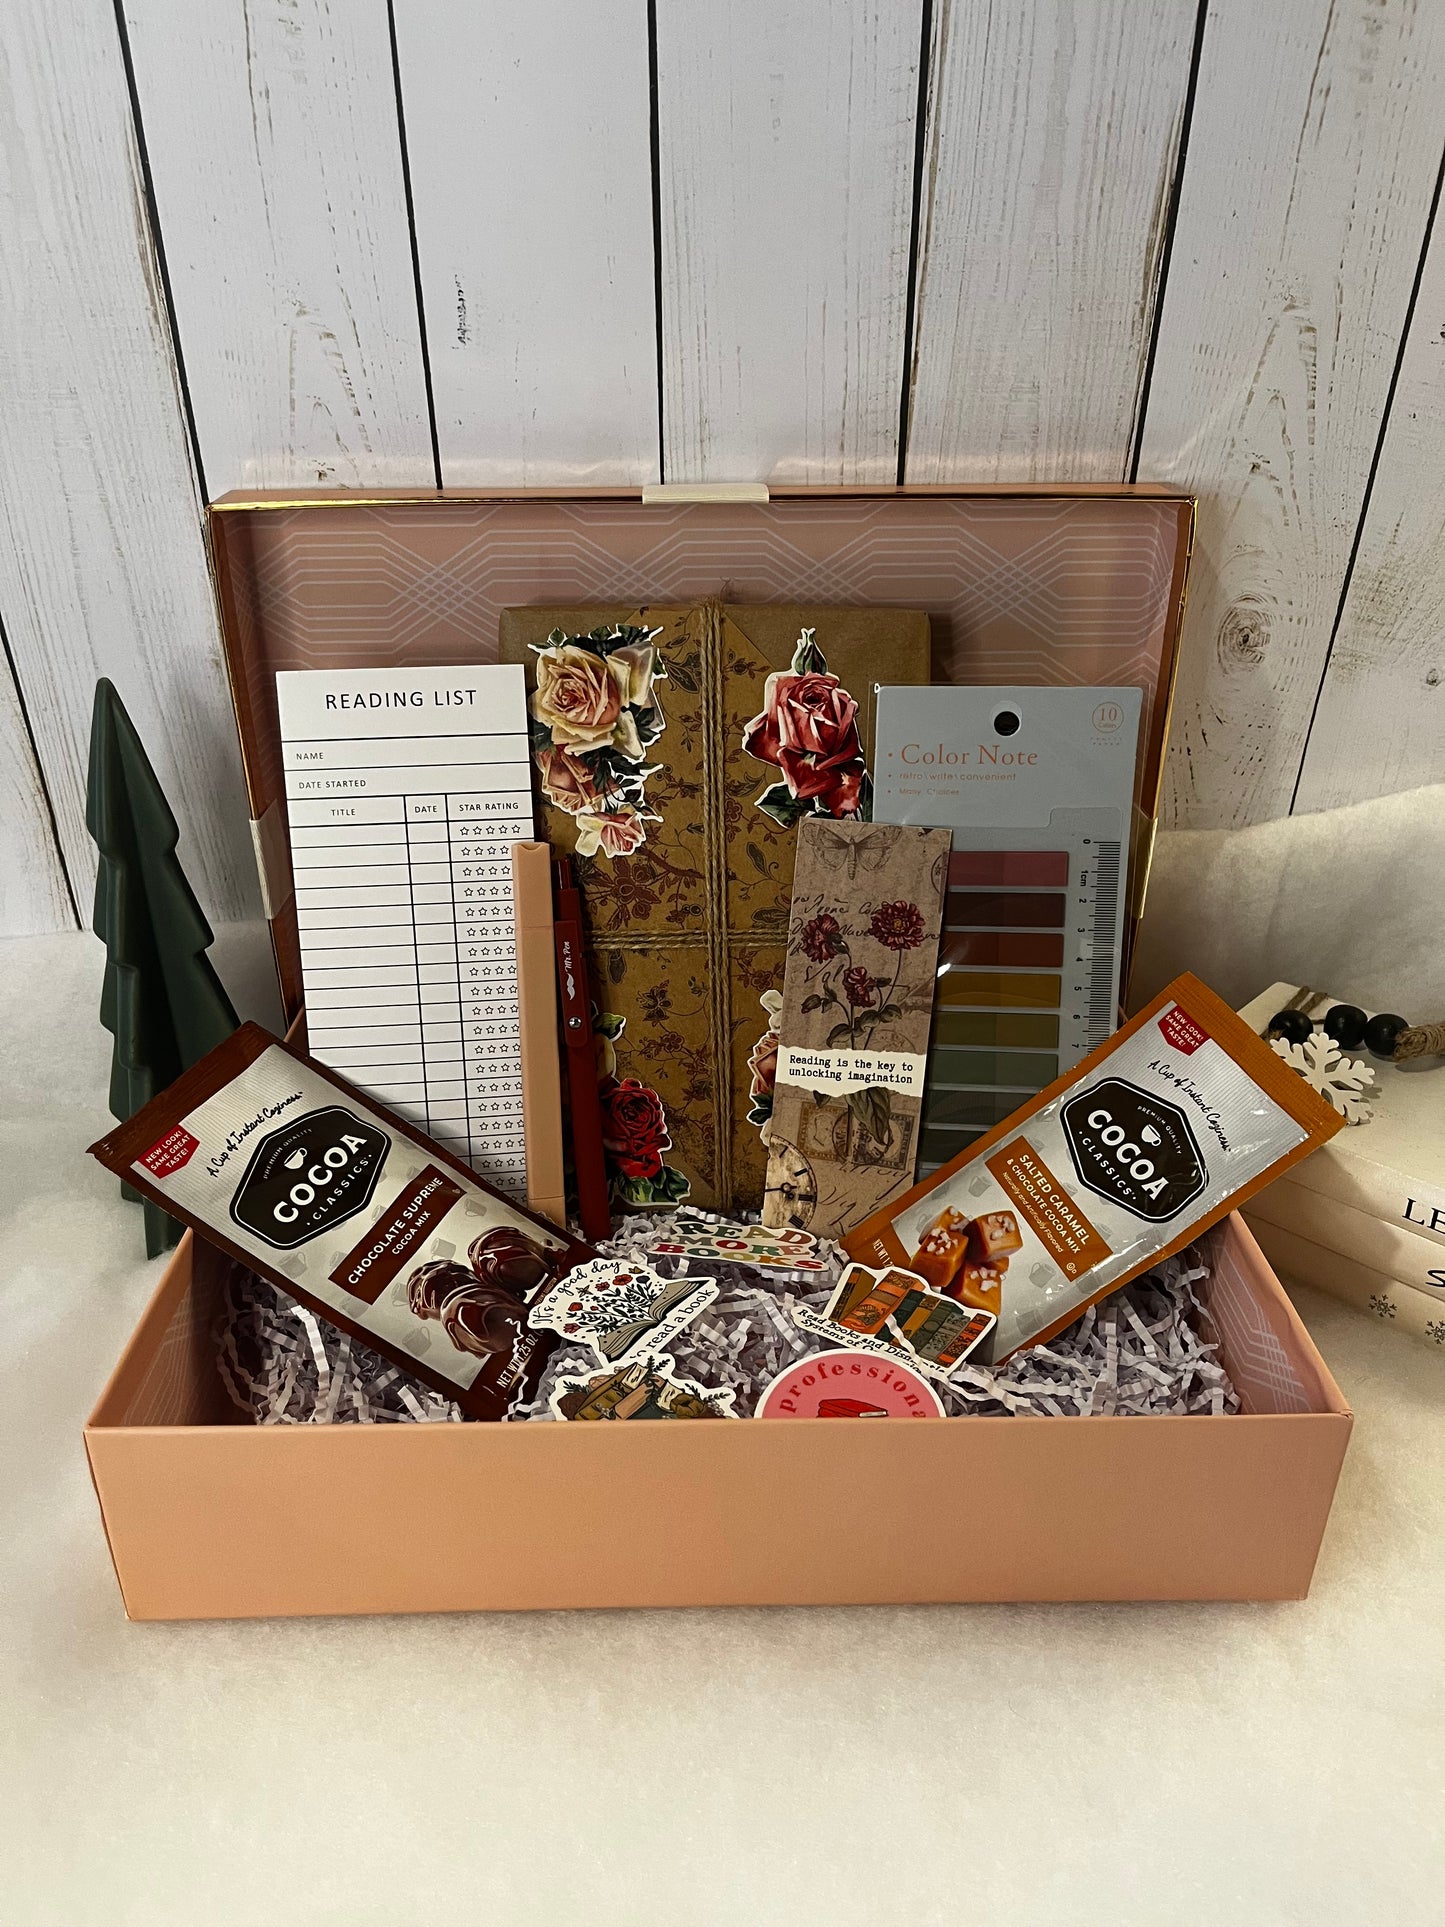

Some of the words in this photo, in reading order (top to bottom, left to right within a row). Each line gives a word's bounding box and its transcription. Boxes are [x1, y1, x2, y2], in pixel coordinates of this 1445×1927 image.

[326, 691, 424, 709] READING
[434, 689, 477, 706] LIST
[1100, 707, 1118, 721] 10
[296, 752, 324, 760] NAME
[901, 743, 970, 766] Color
[978, 744, 1039, 766] Note
[299, 781, 322, 789] DATE
[326, 779, 367, 788] STARTED
[331, 808, 356, 816] TITLE
[414, 805, 438, 813] DATE
[459, 803, 482, 812] STAR
[485, 802, 519, 811] RATING
[1165, 1015, 1182, 1032] SAME
[1180, 1030, 1200, 1048] GREAT
[1166, 1026, 1187, 1047] TASTE!
[1173, 1010, 1188, 1025] NEW
[1186, 1023, 1204, 1042] LOOK!
[789, 1067, 842, 1081] unlocking
[847, 1071, 913, 1084] imagination
[790, 1054, 831, 1068] Reading
[836, 1058, 849, 1067] is
[854, 1059, 872, 1069] the
[877, 1060, 896, 1072] key
[902, 1062, 914, 1072] to
[1147, 1059, 1159, 1070] A
[1157, 1064, 1176, 1082] Cup
[1173, 1077, 1186, 1089] of
[1181, 1081, 1210, 1116] Instant
[225, 1137, 239, 1152] of
[229, 1113, 265, 1145] Instant
[1137, 1105, 1167, 1128] PREMIUM
[1165, 1125, 1183, 1155] QUALITY
[145, 1147, 163, 1164] NEW
[161, 1130, 183, 1150] LOOK!
[150, 1153, 171, 1171] SAME
[169, 1134, 191, 1154] GREAT
[165, 1147, 189, 1169] TASTE!
[211, 1151, 230, 1168] Cup
[1087, 1109, 1170, 1201] COCOA
[205, 1166, 219, 1179] A
[273, 1133, 368, 1223] COCOA
[1081, 1137, 1134, 1196] CLASSICS
[312, 1157, 370, 1221] CLASSICS
[1019, 1154, 1053, 1194] SALTED
[1049, 1193, 1091, 1245] CARAMEL
[1006, 1158, 1013, 1166] &
[1011, 1164, 1047, 1210] CHOCOLATE
[1044, 1207, 1068, 1238] COCOA
[1065, 1235, 1081, 1254] MIX
[348, 1218, 406, 1285] CHOCOLATE
[402, 1177, 444, 1220] SUPREME
[391, 1225, 418, 1256] COCOA
[415, 1210, 432, 1228] MIX
[675, 1223, 813, 1245] READ
[677, 1236, 811, 1256] MORE
[1044, 1229, 1064, 1253] Flavored
[652, 1243, 824, 1270] BOOKS
[532, 1306, 556, 1325] It's
[548, 1294, 559, 1305] a
[557, 1268, 588, 1297] good
[591, 1260, 622, 1274] day
[645, 1322, 677, 1349] read
[673, 1315, 687, 1324] a
[682, 1288, 715, 1315] book
[797, 1308, 828, 1326] Read
[826, 1318, 861, 1342] Books
[860, 1337, 886, 1350] and
[800, 1318, 846, 1342] Systems
[846, 1338, 864, 1349] of
[496, 1370, 513, 1389] NET
[507, 1358, 521, 1373] WT
[526, 1333, 539, 1347] OZ
